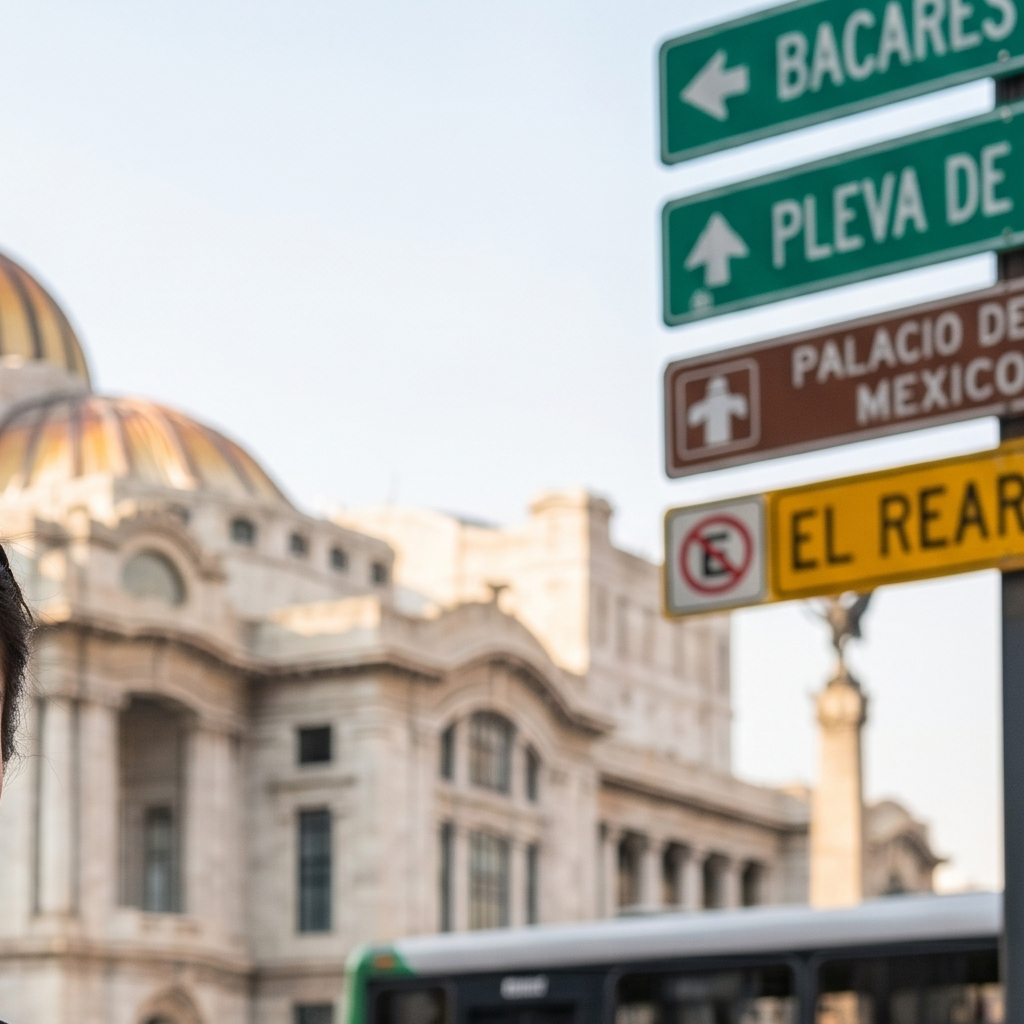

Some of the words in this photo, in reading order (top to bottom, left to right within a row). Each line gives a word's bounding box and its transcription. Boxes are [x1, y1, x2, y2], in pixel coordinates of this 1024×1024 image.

[776, 0, 1017, 101] BACARES
[772, 165, 928, 269] PLEVA
[945, 141, 1013, 226] DE
[792, 312, 963, 388] PALACIO
[978, 294, 1024, 348] DE
[856, 351, 1024, 425] MEXICO
[791, 504, 854, 573] EL
[880, 472, 1024, 557] REAR
